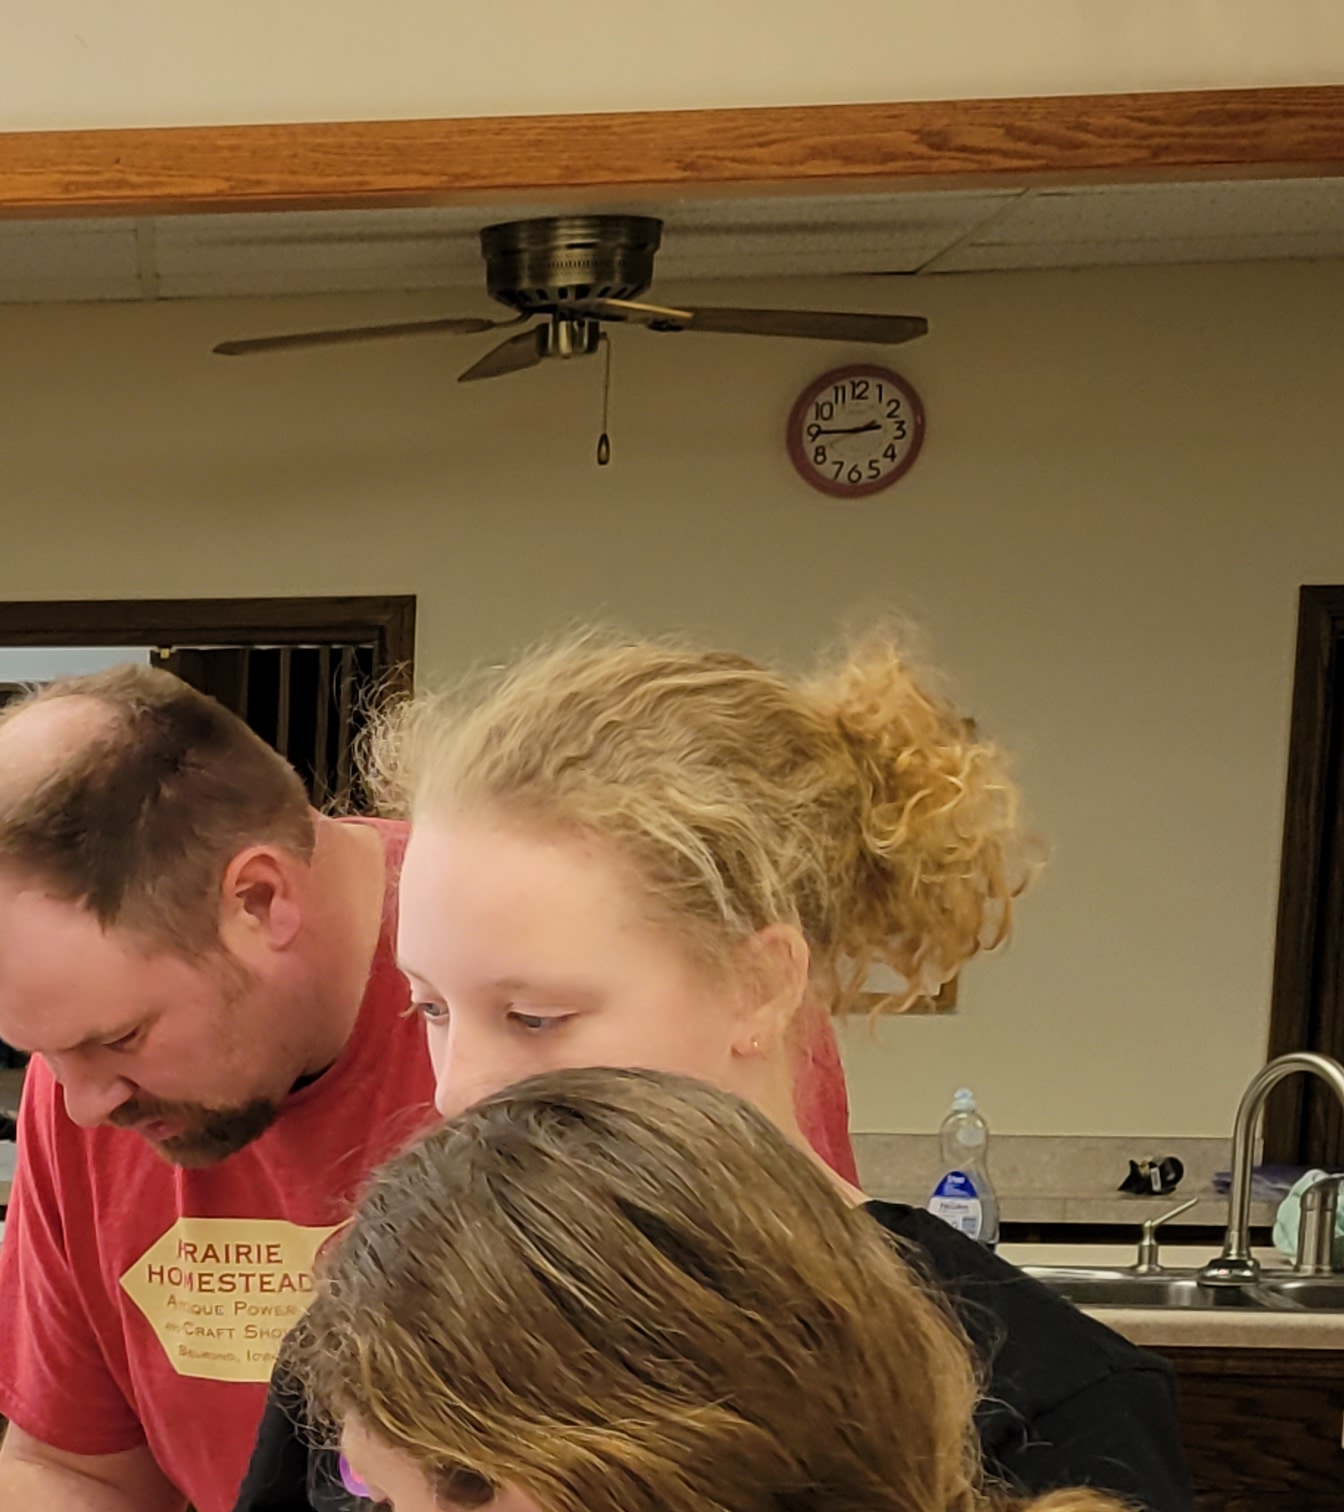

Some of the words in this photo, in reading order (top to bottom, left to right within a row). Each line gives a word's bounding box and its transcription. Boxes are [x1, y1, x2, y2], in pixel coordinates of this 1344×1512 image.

[834, 386, 845, 404] 11
[849, 380, 870, 401] 12
[875, 383, 883, 404] 1
[814, 402, 834, 421] 10
[886, 399, 901, 419] 2
[807, 423, 822, 444] 9
[893, 420, 907, 440] 3
[813, 445, 827, 466] 8
[883, 443, 897, 462] 4
[831, 461, 845, 481] 7
[847, 464, 862, 484] 6
[867, 460, 881, 480] 5
